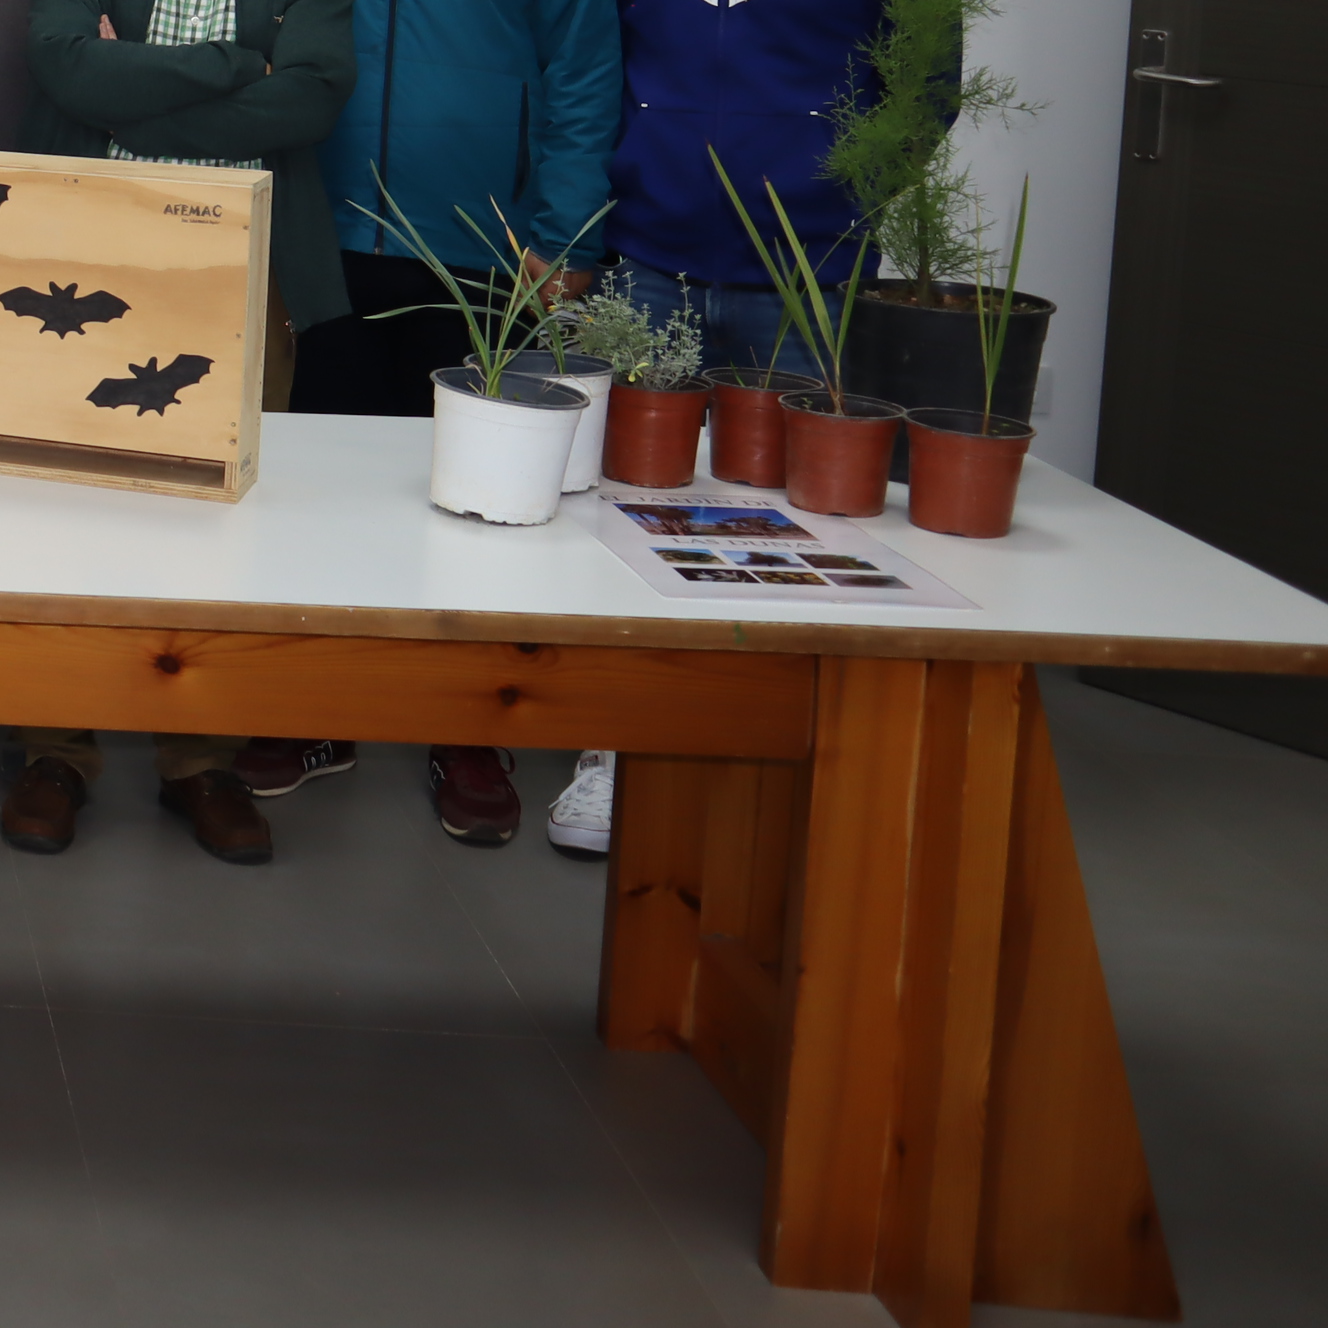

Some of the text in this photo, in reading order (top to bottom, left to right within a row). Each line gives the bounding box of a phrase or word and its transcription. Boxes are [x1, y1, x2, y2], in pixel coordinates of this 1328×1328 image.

[163, 203, 223, 218] AFEMAC
[598, 494, 629, 502] EL
[742, 500, 778, 508] DE
[671, 537, 826, 550] LAS DUNAS
